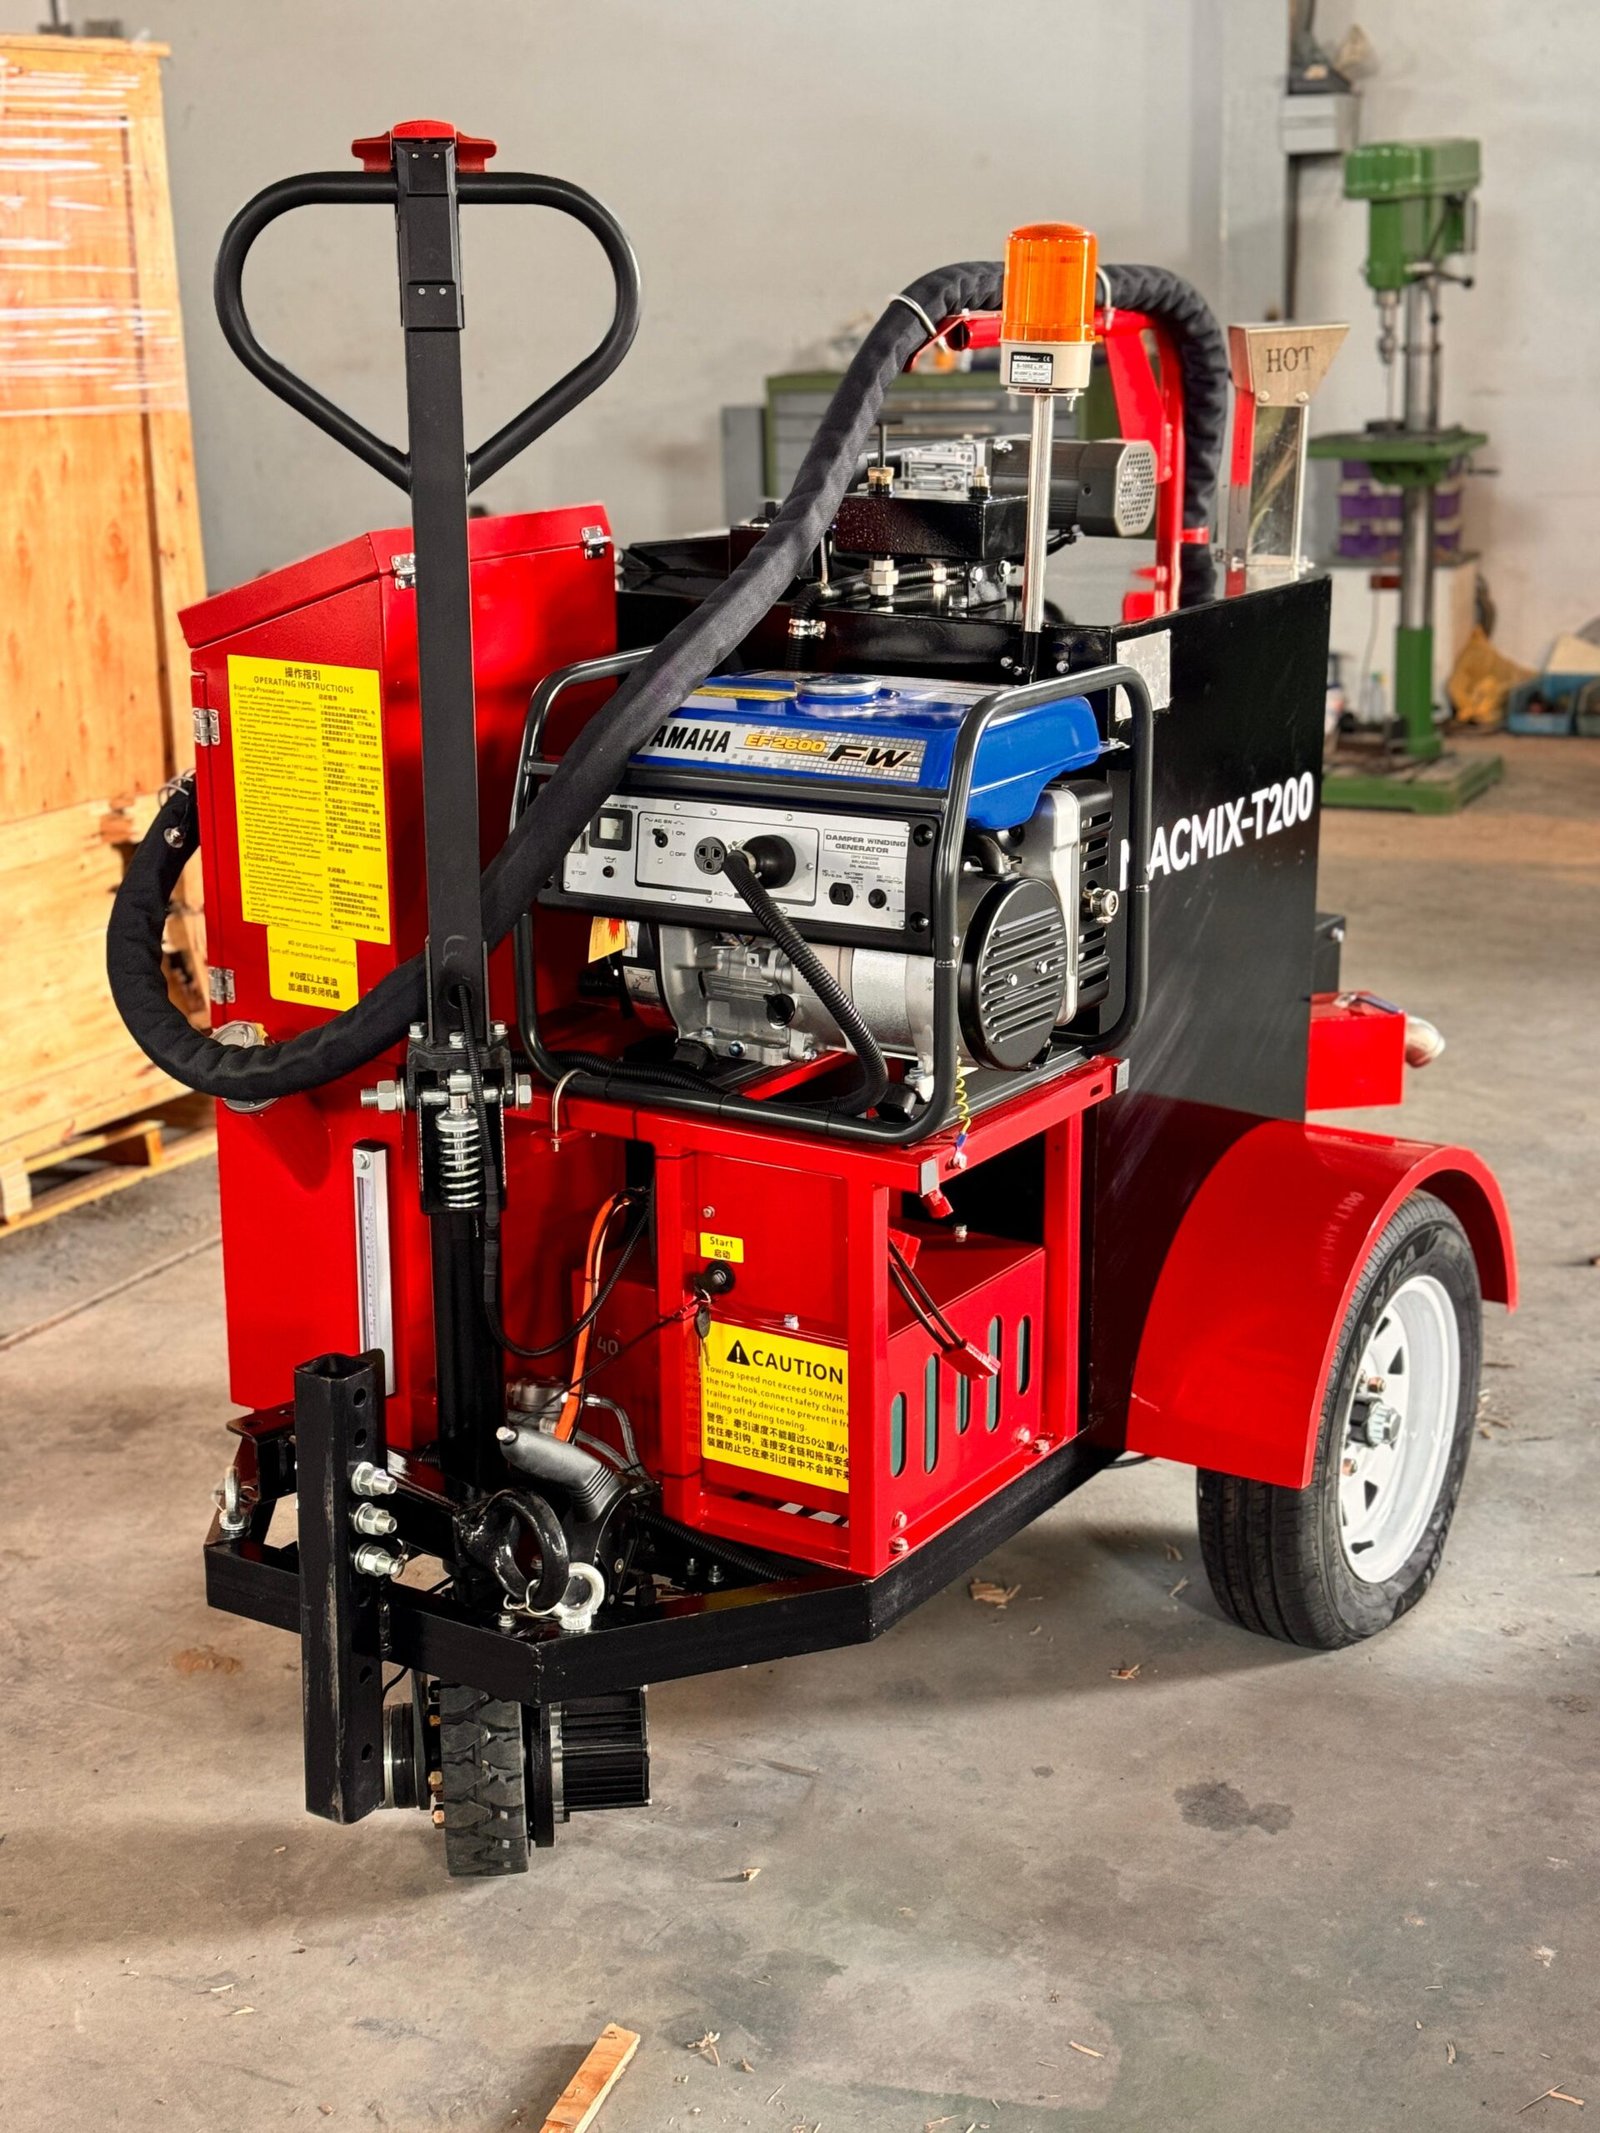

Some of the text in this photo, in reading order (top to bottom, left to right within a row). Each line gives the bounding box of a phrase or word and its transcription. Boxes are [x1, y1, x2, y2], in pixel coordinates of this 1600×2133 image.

[1266, 345, 1316, 373] HOT
[285, 667, 321, 682] 操作指引
[253, 676, 354, 694] OPERATING INSTRUCTIONS
[649, 725, 911, 769] AMAHA EF2600 FW
[825, 834, 906, 847] DAMPER WINDING
[835, 843, 889, 854] GENERATOR
[269, 946, 281, 954] Turn
[290, 950, 313, 959] machine
[313, 952, 331, 962] before
[302, 941, 319, 950] above
[710, 1236, 734, 1249] Start
[714, 1248, 731, 1259] 启动
[752, 1350, 843, 1385] CAUTION
[706, 1376, 719, 1386] the
[721, 1379, 736, 1389] tow
[795, 1396, 820, 1411] safety
[821, 1402, 845, 1415] chain
[736, 1371, 760, 1384] speed
[762, 1377, 776, 1387] not
[778, 1381, 807, 1394] exceed
[808, 1387, 846, 1404] 50KM/H.
[706, 1388, 731, 1400] trailer
[732, 1393, 757, 1408] safety
[758, 1399, 785, 1413] device
[787, 1407, 796, 1416] to
[797, 1409, 830, 1424] prevent
[831, 1417, 838, 1425] it
[706, 1400, 733, 1414] falling
[734, 1405, 746, 1416] off
[747, 1407, 774, 1424] during
